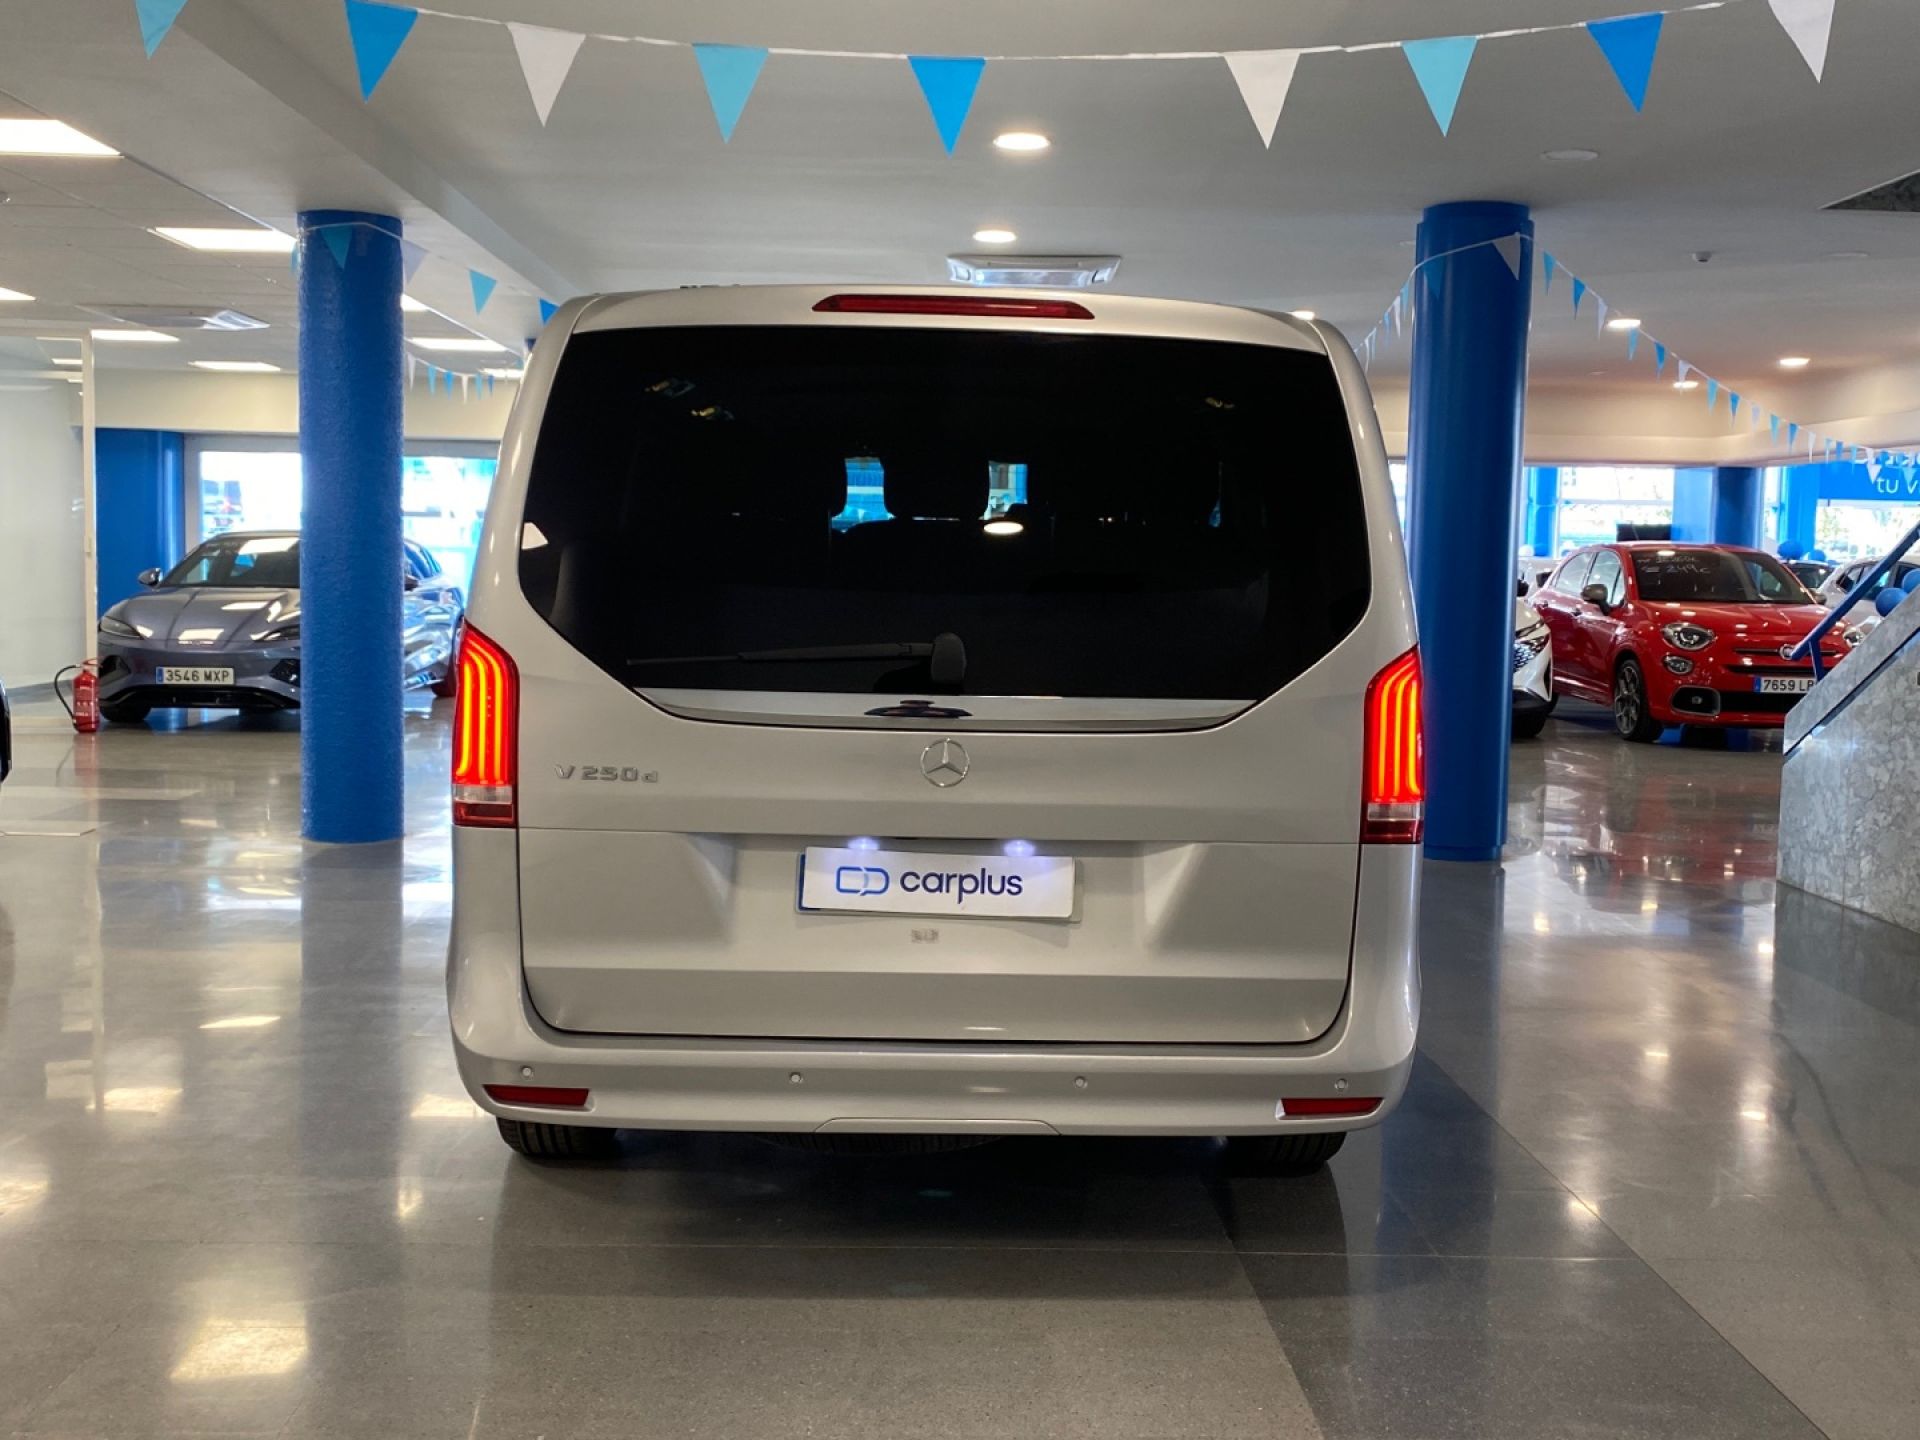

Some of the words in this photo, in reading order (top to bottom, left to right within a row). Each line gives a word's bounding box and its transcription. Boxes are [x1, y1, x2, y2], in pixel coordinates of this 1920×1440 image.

[1876, 477, 1900, 494] tu
[1906, 479, 1920, 495] v
[165, 669, 200, 682] 3546
[203, 669, 230, 682] MXP
[1763, 679, 1796, 691] 7659
[554, 764, 576, 780] V
[899, 867, 1024, 905] carplus
